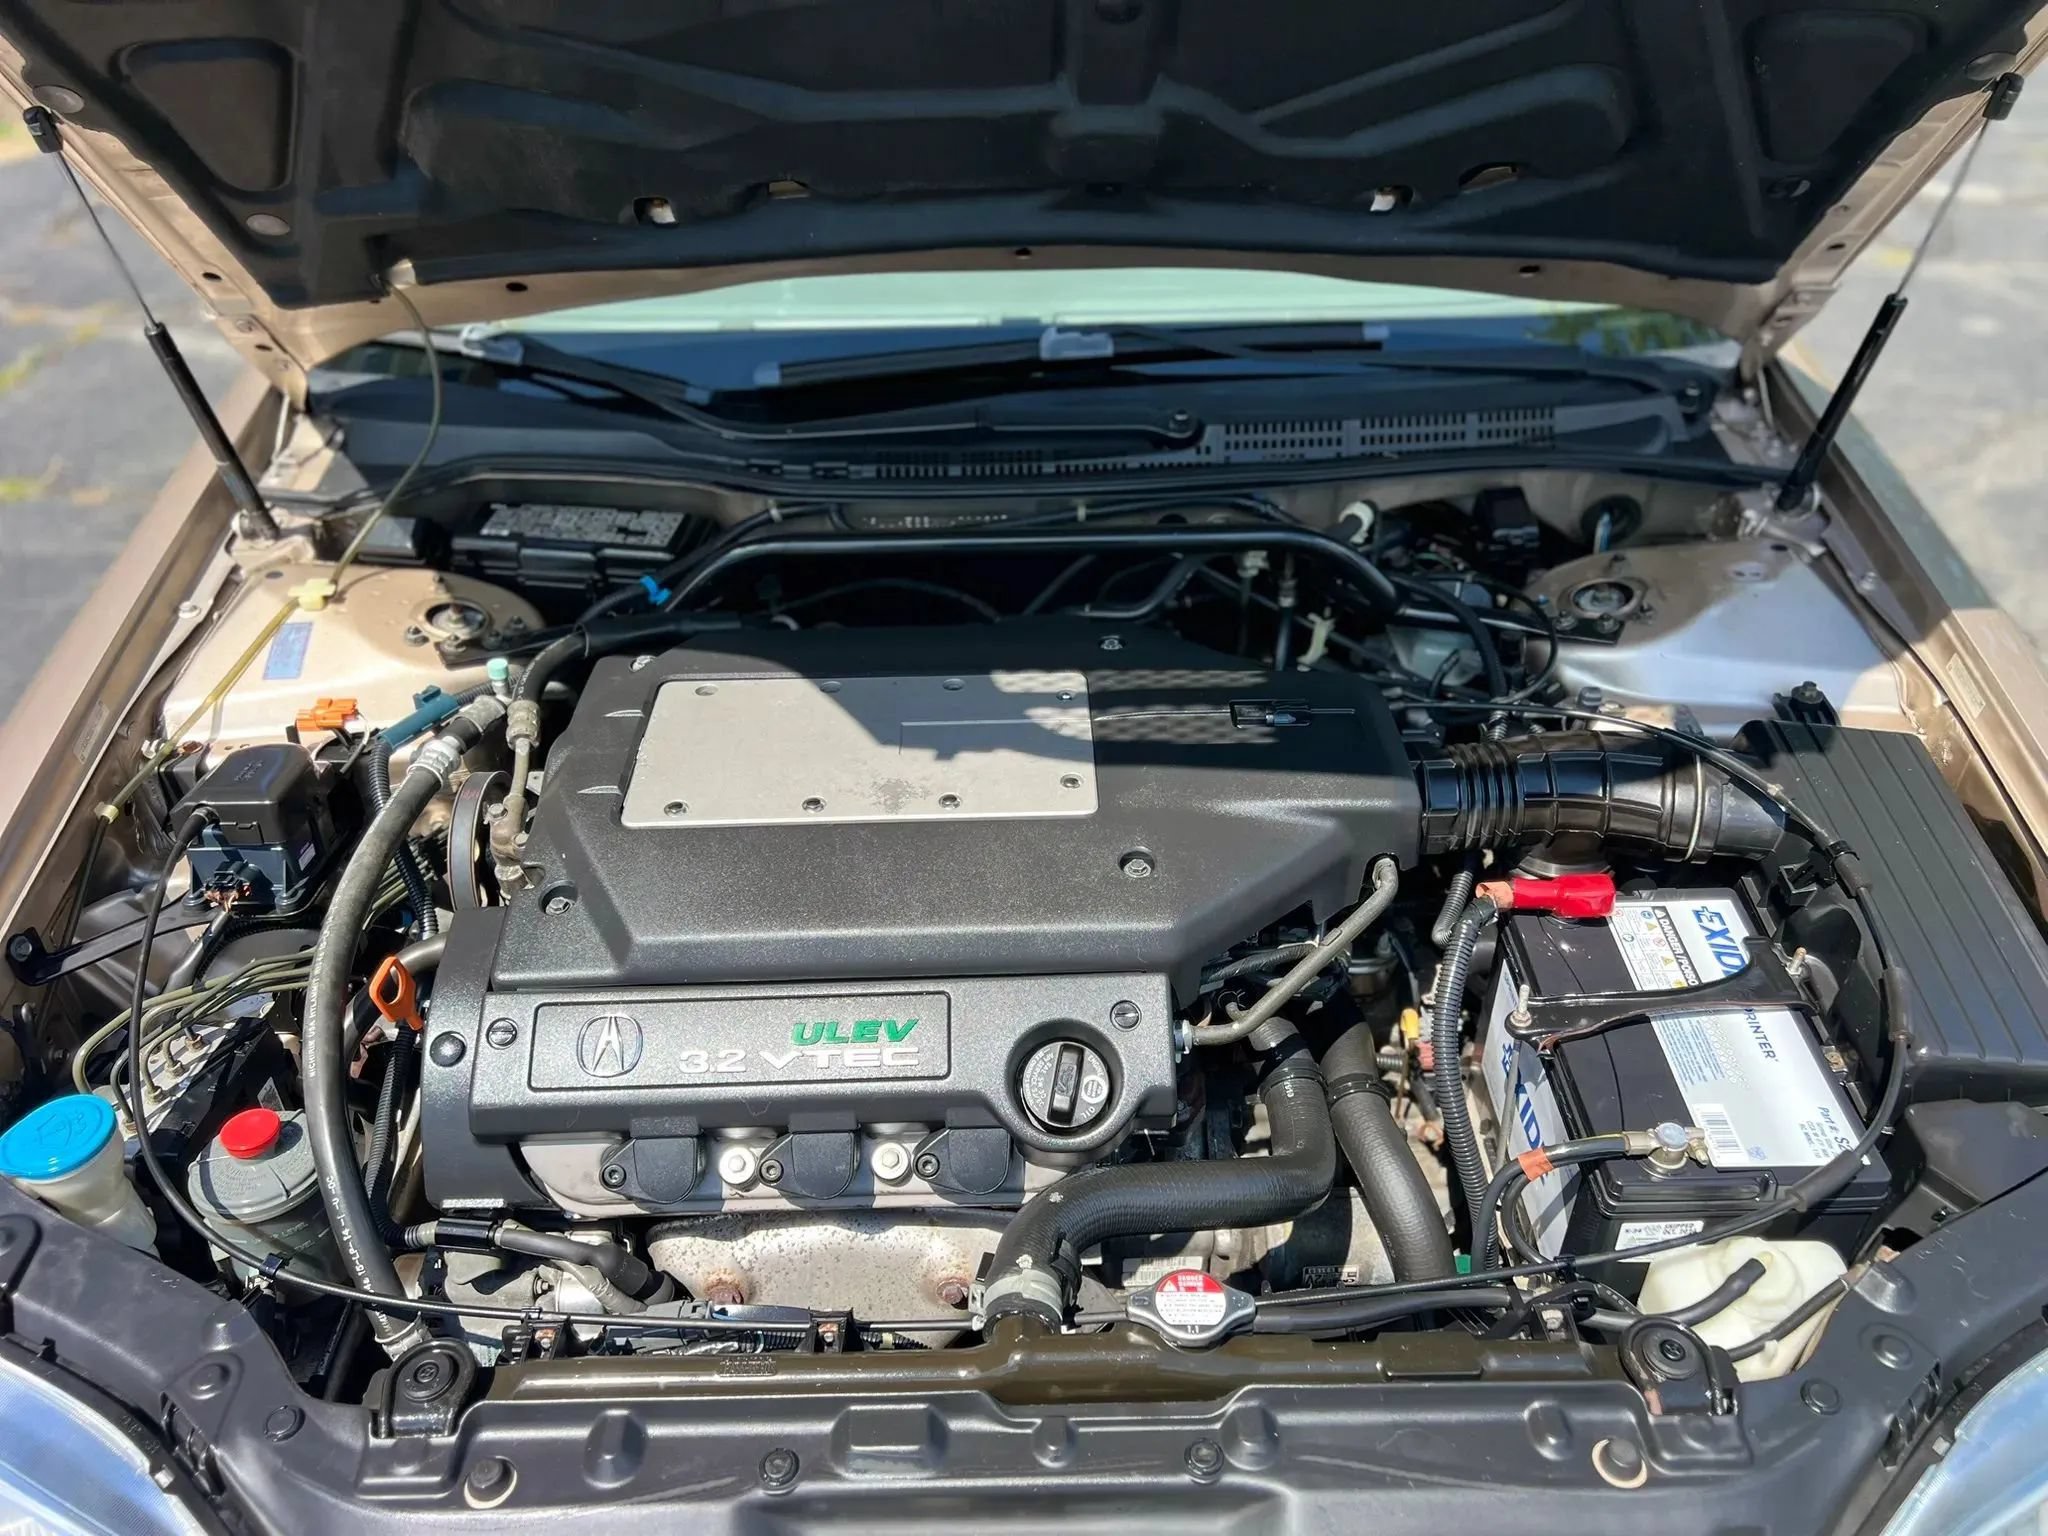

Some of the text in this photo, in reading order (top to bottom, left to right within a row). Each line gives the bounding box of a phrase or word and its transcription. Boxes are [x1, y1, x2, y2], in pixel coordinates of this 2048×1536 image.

[1692, 906, 1748, 976] EXID
[791, 1018, 919, 1045] ULEV
[678, 1046, 920, 1074] 3.2 VTEC
[1080, 1106, 1094, 1119] OIL
[1834, 1136, 1853, 1152] S2
[1186, 1325, 1200, 1334] 1.1
